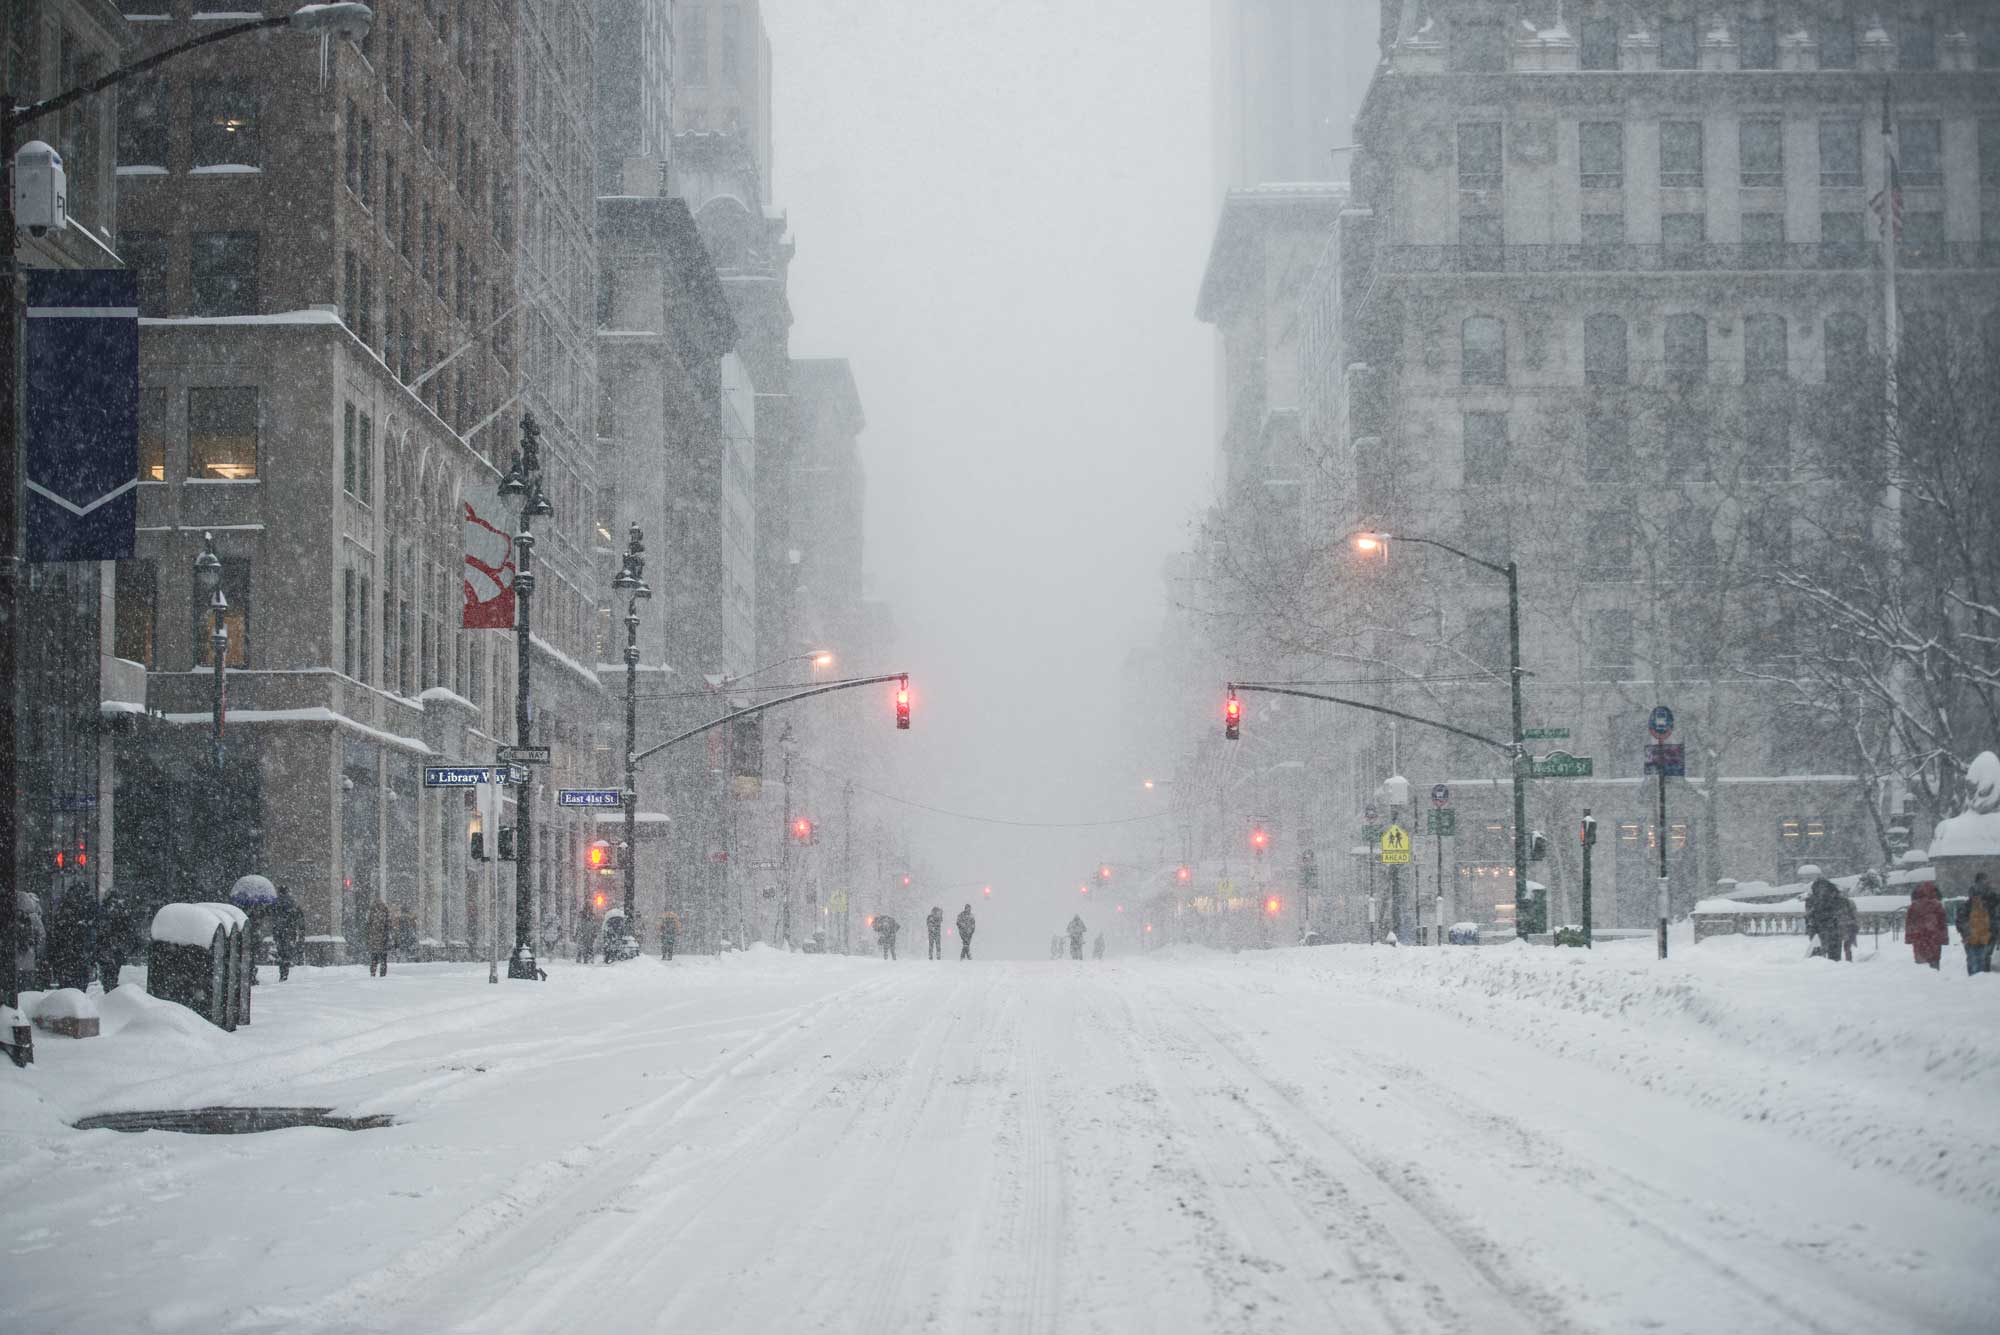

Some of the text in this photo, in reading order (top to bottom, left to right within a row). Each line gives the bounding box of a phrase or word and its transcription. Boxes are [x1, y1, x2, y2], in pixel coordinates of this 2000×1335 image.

[503, 751, 544, 759] ONE WAY
[439, 772, 479, 783] Library
[565, 794, 615, 803] East 41st St
